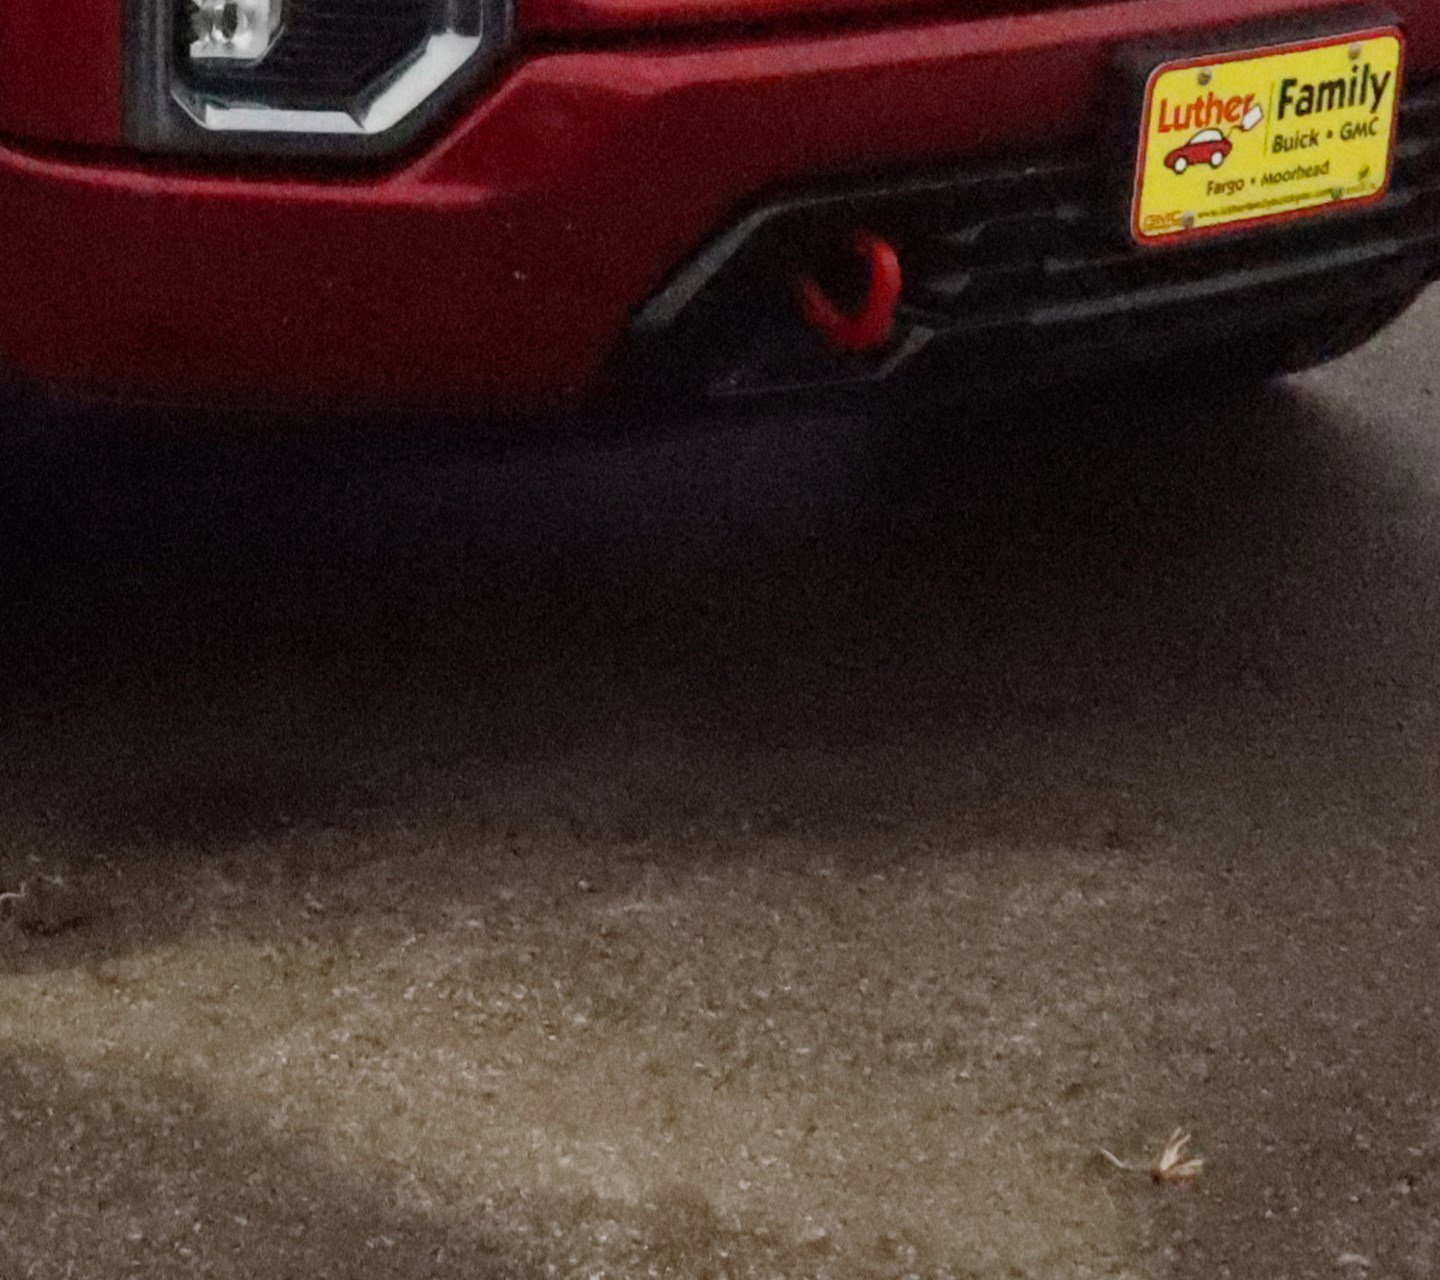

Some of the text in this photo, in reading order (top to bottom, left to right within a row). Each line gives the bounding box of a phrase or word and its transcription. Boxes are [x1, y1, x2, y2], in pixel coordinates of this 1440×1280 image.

[1158, 63, 1392, 133] Luther Family
[1272, 116, 1380, 154] Buick GMC
[1206, 176, 1245, 197] Fargo
[1260, 160, 1330, 188] Moorhead
